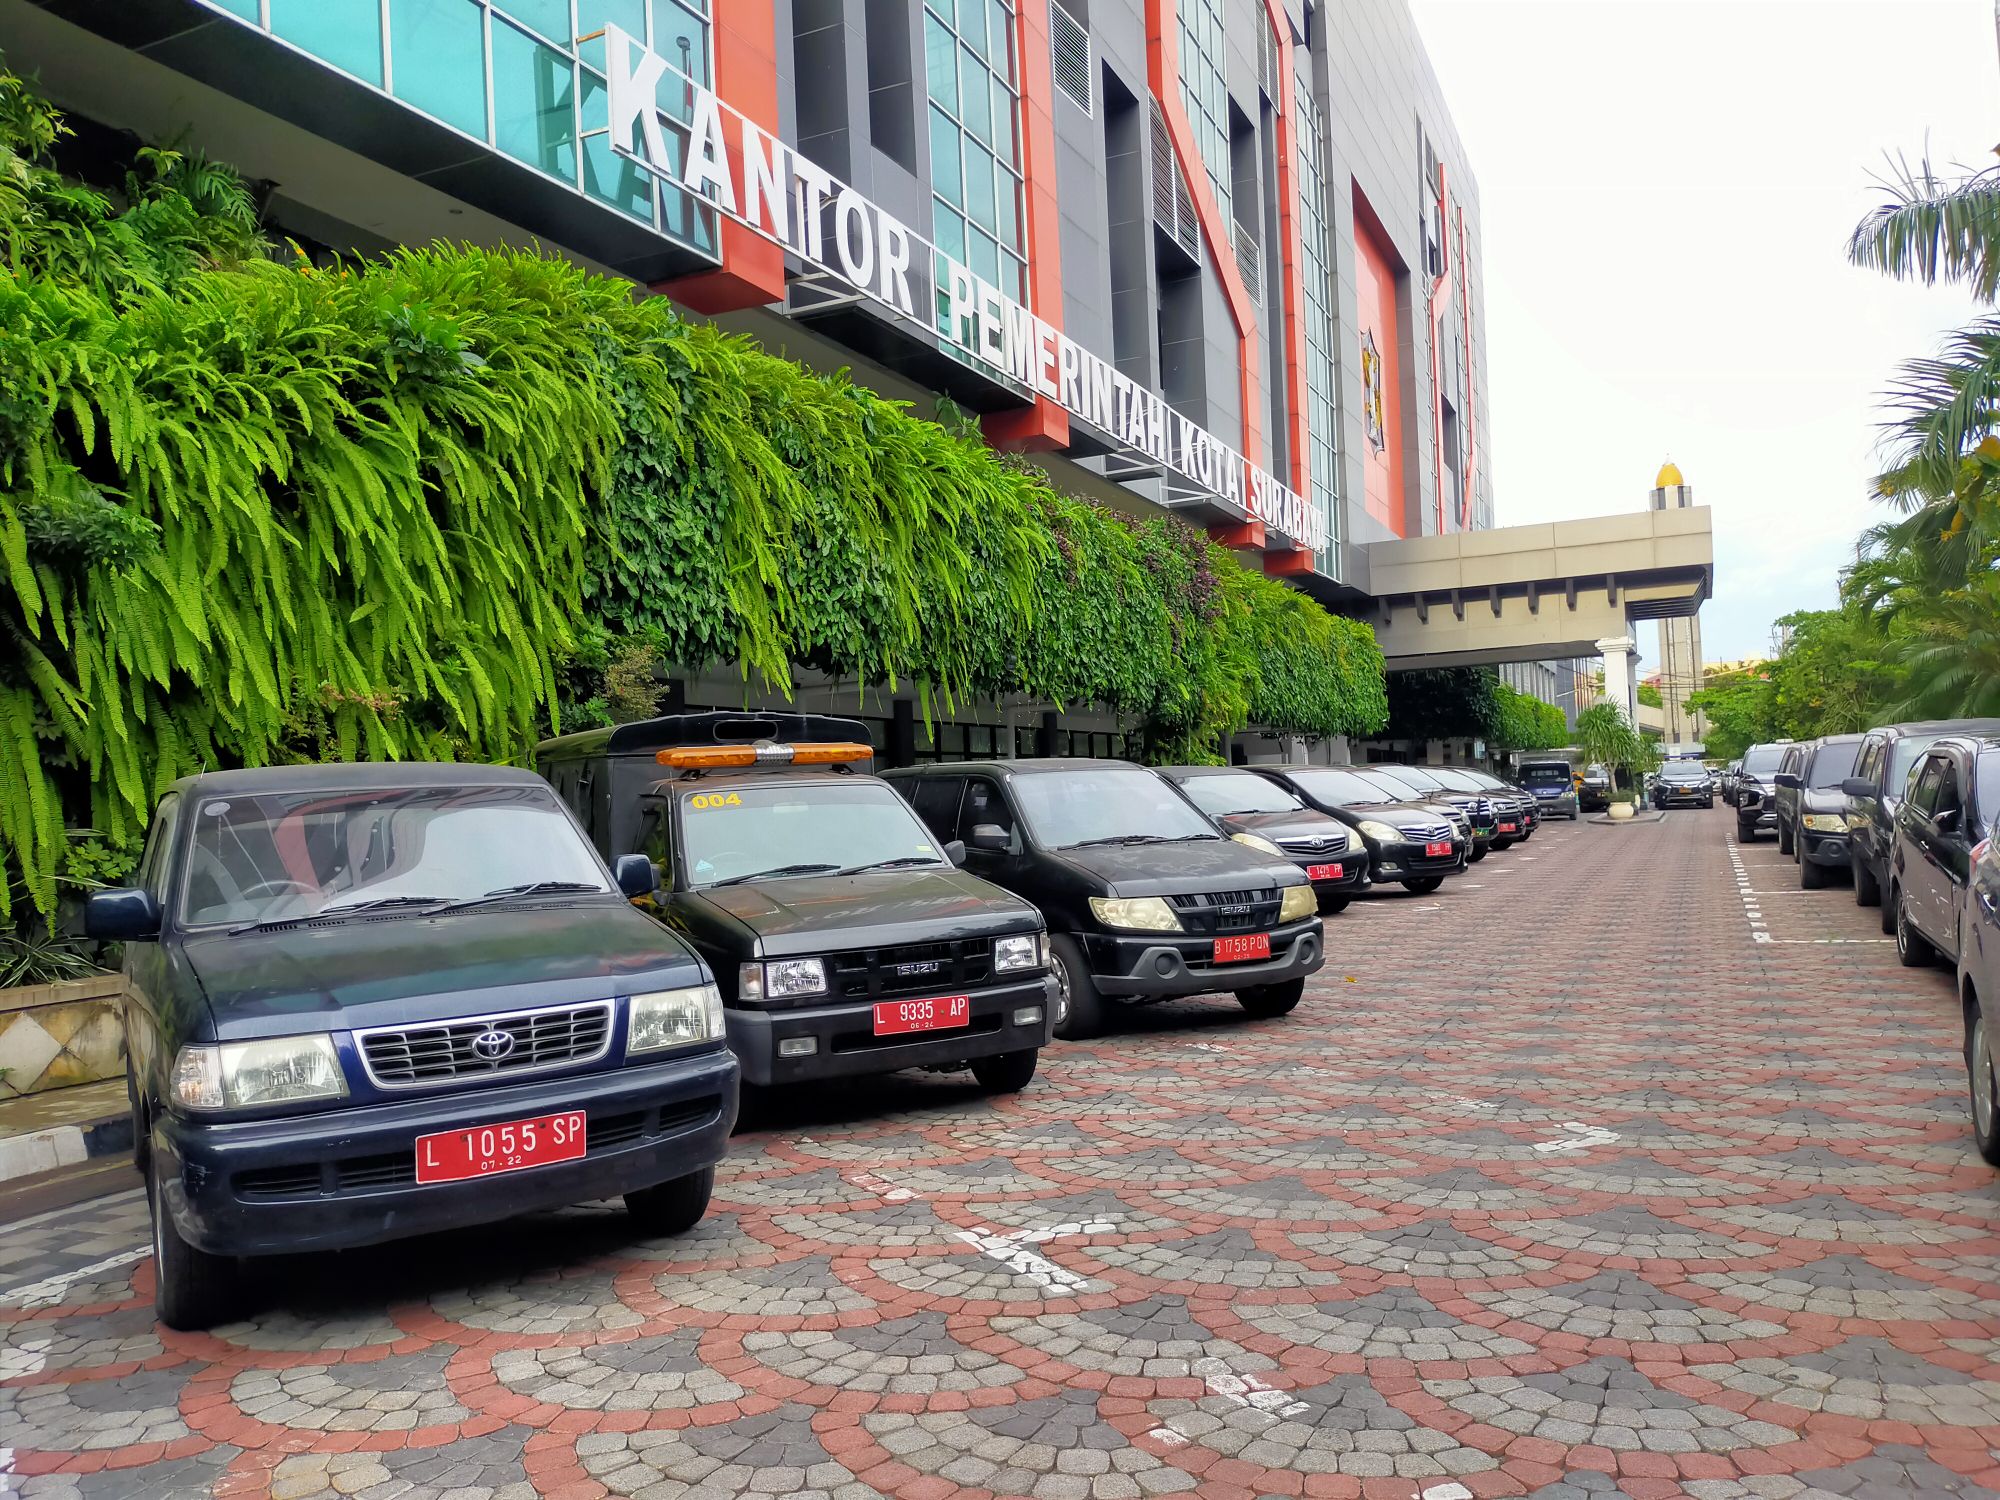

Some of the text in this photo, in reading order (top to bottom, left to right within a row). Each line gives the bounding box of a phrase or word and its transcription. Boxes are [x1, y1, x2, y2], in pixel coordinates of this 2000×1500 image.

[605, 22, 1326, 556] KANTOR PEMERINTAH KOTA SURABAYA
[691, 792, 743, 809] 004
[1221, 905, 1251, 915] ISUZU
[1215, 941, 1221, 954] B
[1225, 938, 1248, 953] 1758
[897, 962, 939, 976] ISUZU
[877, 998, 966, 1024] L 9335 AP
[426, 1116, 581, 1167] L 1055 SP
